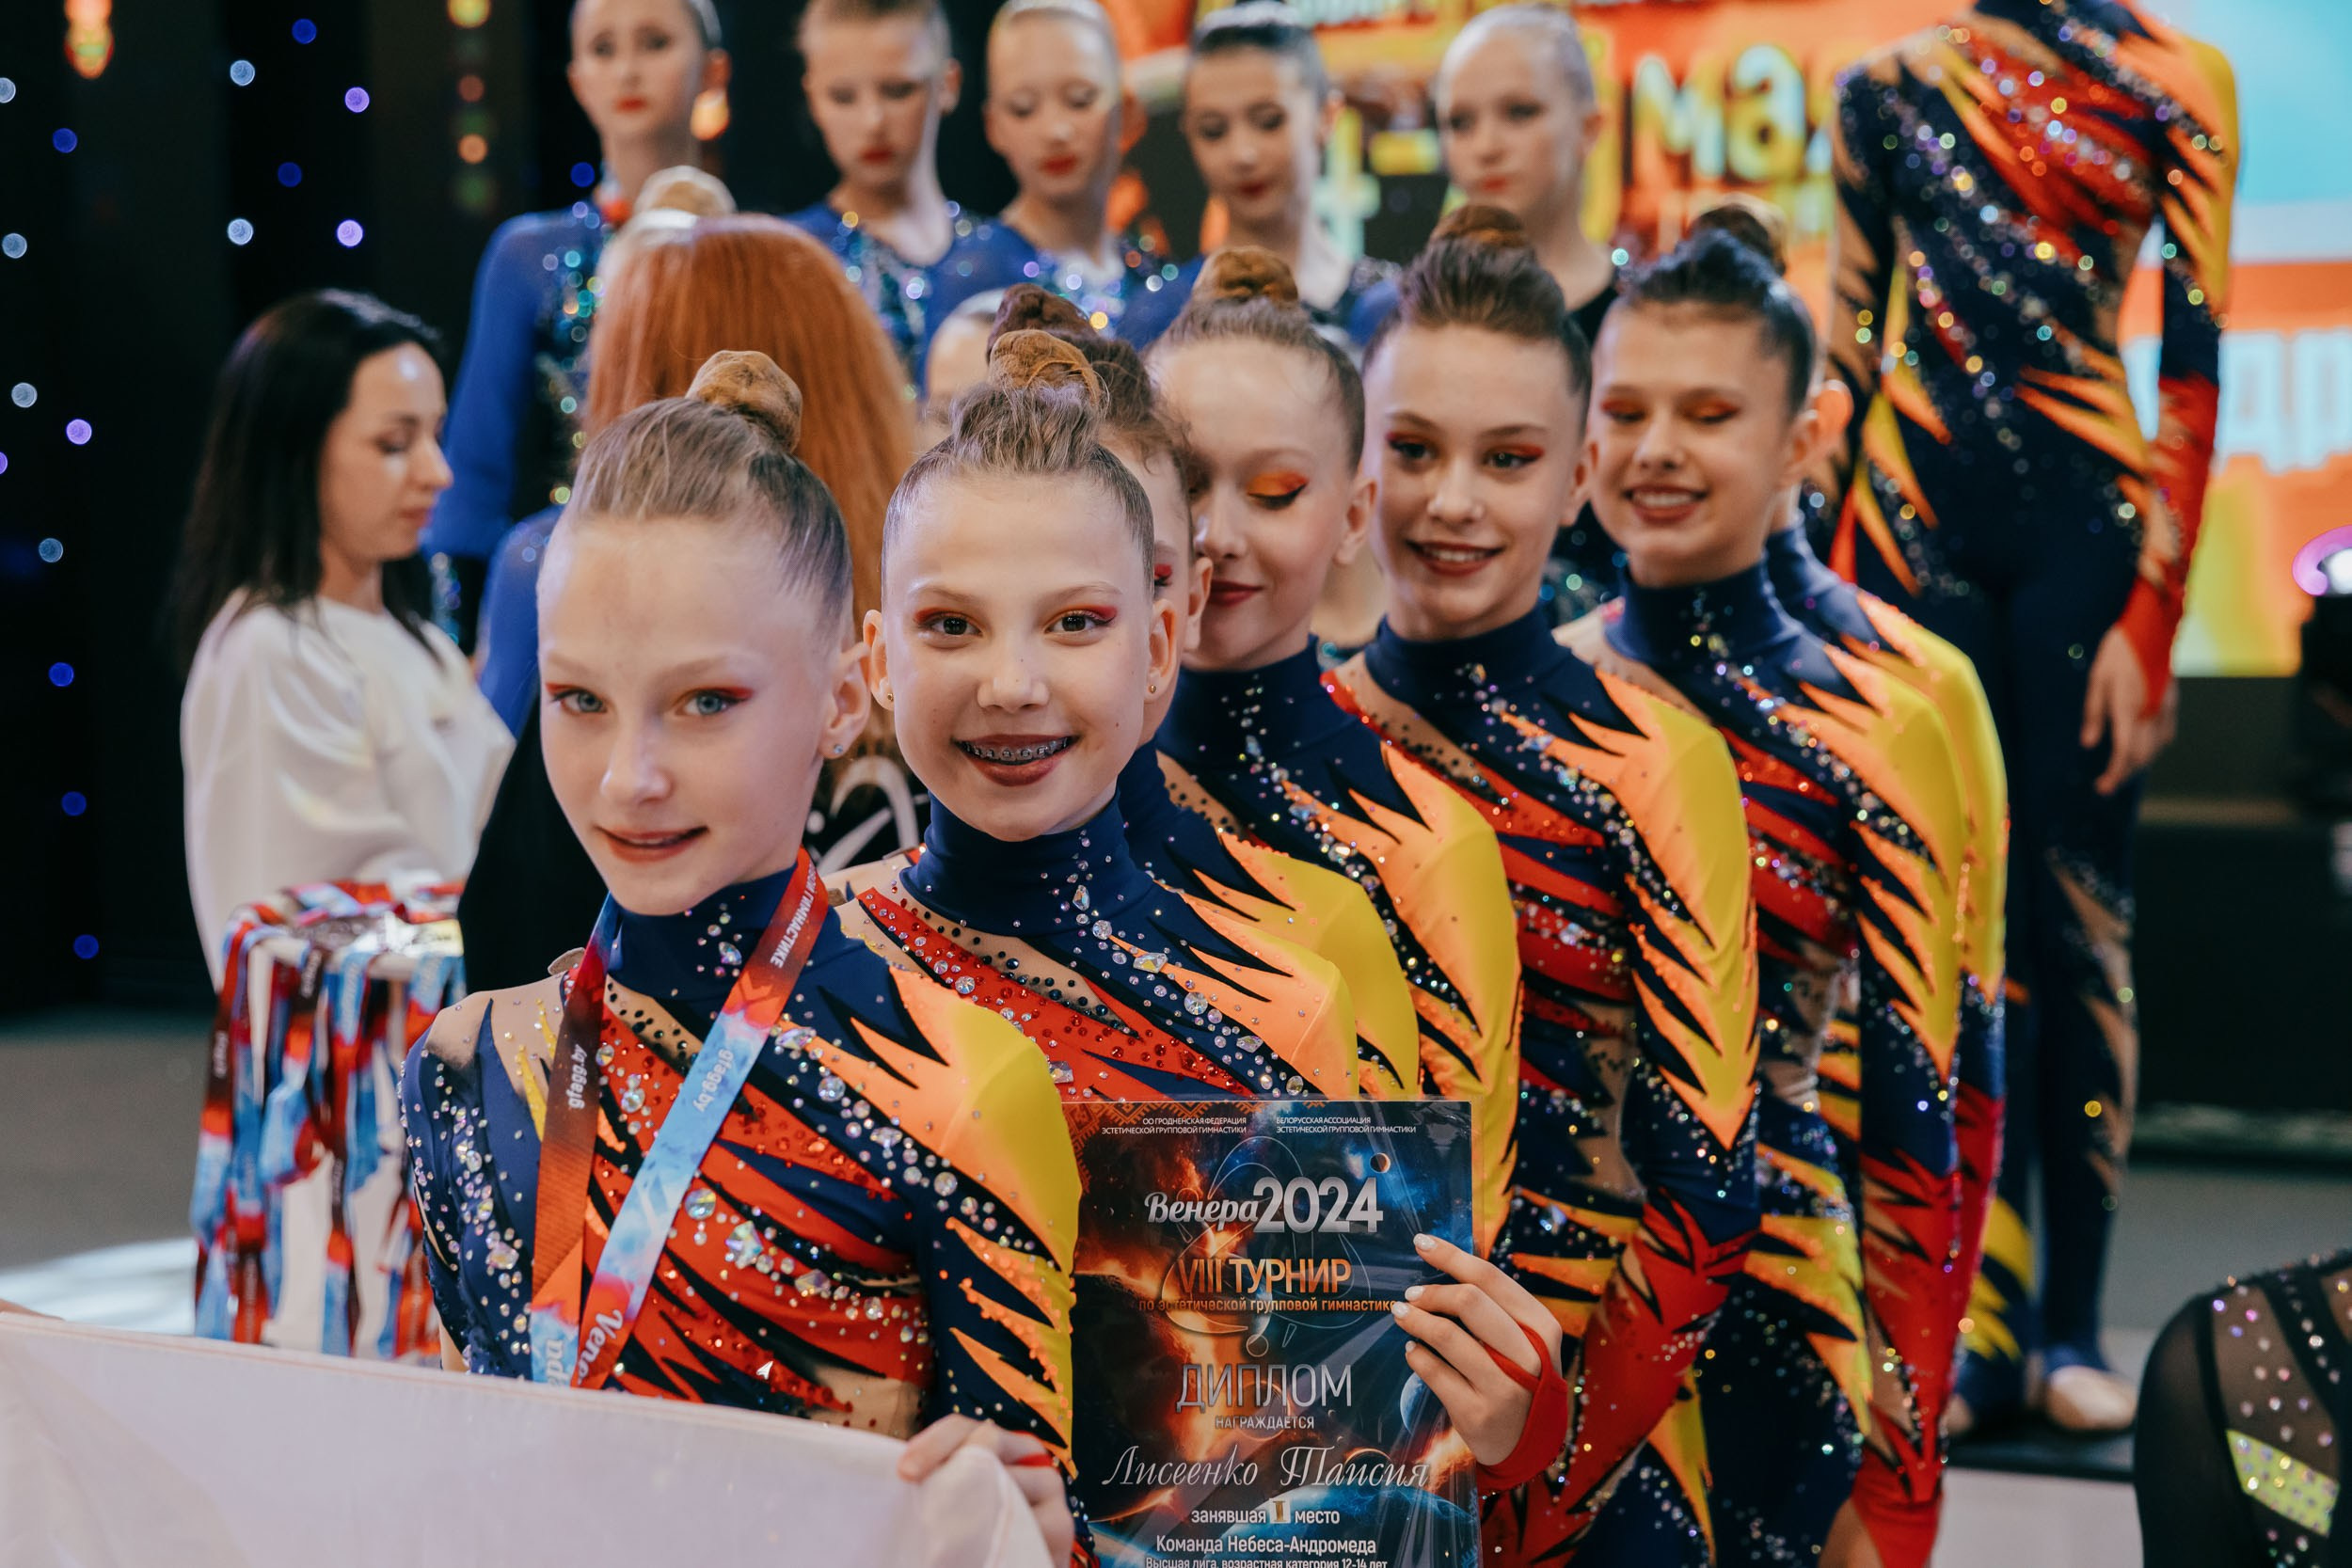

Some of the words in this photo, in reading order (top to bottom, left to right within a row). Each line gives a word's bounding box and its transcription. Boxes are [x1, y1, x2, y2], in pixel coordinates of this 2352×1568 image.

[771, 890, 814, 969] ГИМНАСТИКЕ
[566, 1044, 588, 1110] gfagg.by
[692, 1048, 734, 1113] gfagg.by
[1102, 1125, 1155, 1134] ЭСТЕТИЧЕСКОЙ
[1156, 1125, 1199, 1134] ГРУППОВОЙ
[1200, 1126, 1247, 1134] ГИМНАСТИКИ
[1155, 1117, 1204, 1126] ГРОДНЕНСКАЯ
[1205, 1117, 1247, 1126] ФЕДЕРАЦИЯ
[1276, 1125, 1327, 1133] ЭСТЕТИЧЕСКОЙ
[1328, 1125, 1370, 1133] ГРУППОВОЙ
[1324, 1117, 1371, 1125] АССОЦИАЦИЯ
[1144, 1192, 1259, 1231] Венера
[1253, 1177, 1383, 1233] 2024
[1178, 1259, 1222, 1293] VIII
[1229, 1258, 1352, 1293] ТУРНИР
[1139, 1300, 1154, 1311] по
[1158, 1297, 1247, 1311] эстетической
[1249, 1297, 1317, 1314] групповой
[1176, 1363, 1353, 1413] ДИПЛОМ
[1215, 1416, 1315, 1430] НАГРАЖДАЕТСЯ
[1102, 1445, 1259, 1486] Лисеенко
[1279, 1446, 1430, 1487] Таисия
[1191, 1510, 1266, 1524] занявшая
[1295, 1510, 1341, 1524] место
[1156, 1535, 1223, 1554] Команда
[1228, 1534, 1376, 1556] Небеса-Андромеда
[1146, 1557, 1190, 1568] Высшая
[1221, 1560, 1283, 1568] возрастная
[1285, 1560, 1340, 1568] категория
[1342, 1558, 1367, 1568] 12-14
[1370, 1560, 1389, 1568] лет
